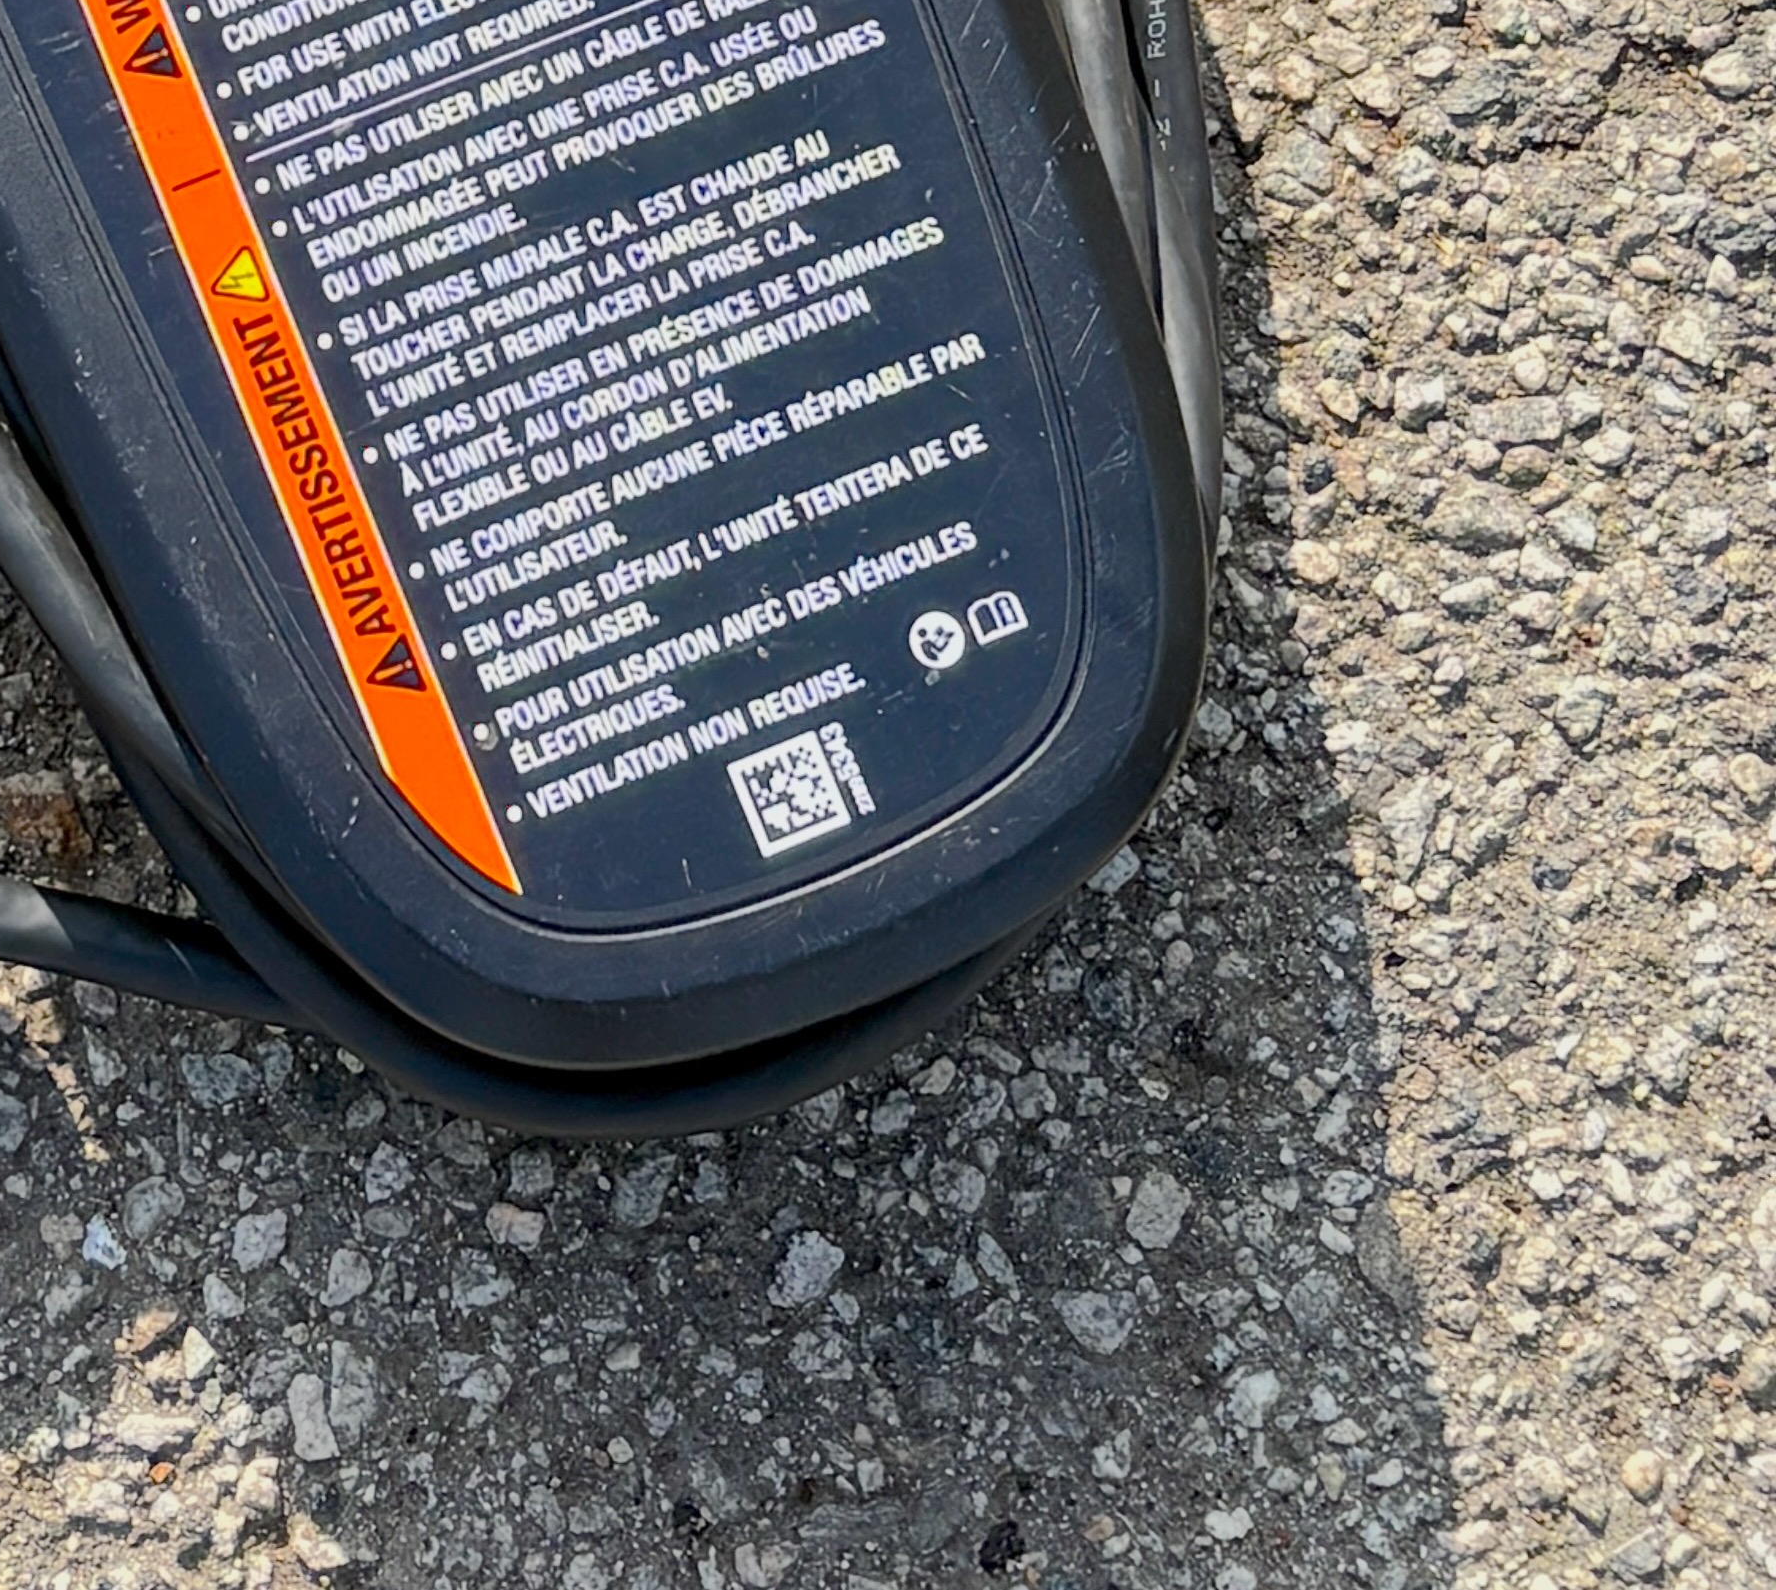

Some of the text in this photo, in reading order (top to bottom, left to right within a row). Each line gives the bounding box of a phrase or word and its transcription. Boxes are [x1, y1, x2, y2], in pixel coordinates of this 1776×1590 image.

[237, 54, 293, 95] FOR
[291, 33, 346, 73] USE
[343, 7, 411, 52] WITH
[253, 55, 411, 136] VENTILATION
[411, 34, 461, 75] NOT
[276, 155, 316, 190] NE
[315, 134, 367, 175] PAS
[368, 91, 479, 153] UTILISER
[480, 65, 543, 111] AVEC
[543, 48, 584, 84] UN
[585, 16, 667, 68] CÂBLE
[665, 1, 705, 36] DE
[307, 20, 886, 268] ENDOMMAGÉE PEUT PROVOQUER DES BRÛLURES
[339, 130, 830, 346] SI LA PRISE MURALE C.A. EST CHAUDE AU
[234, 316, 396, 636] AVERTISSEMENT
[444, 521, 627, 612] L'UTILISATEUR.
[477, 601, 659, 692] RÉINITIALISER.
[510, 684, 685, 774] ÉLECTRIQUES.
[526, 663, 866, 818] VENTILATION NON REQUISE.
